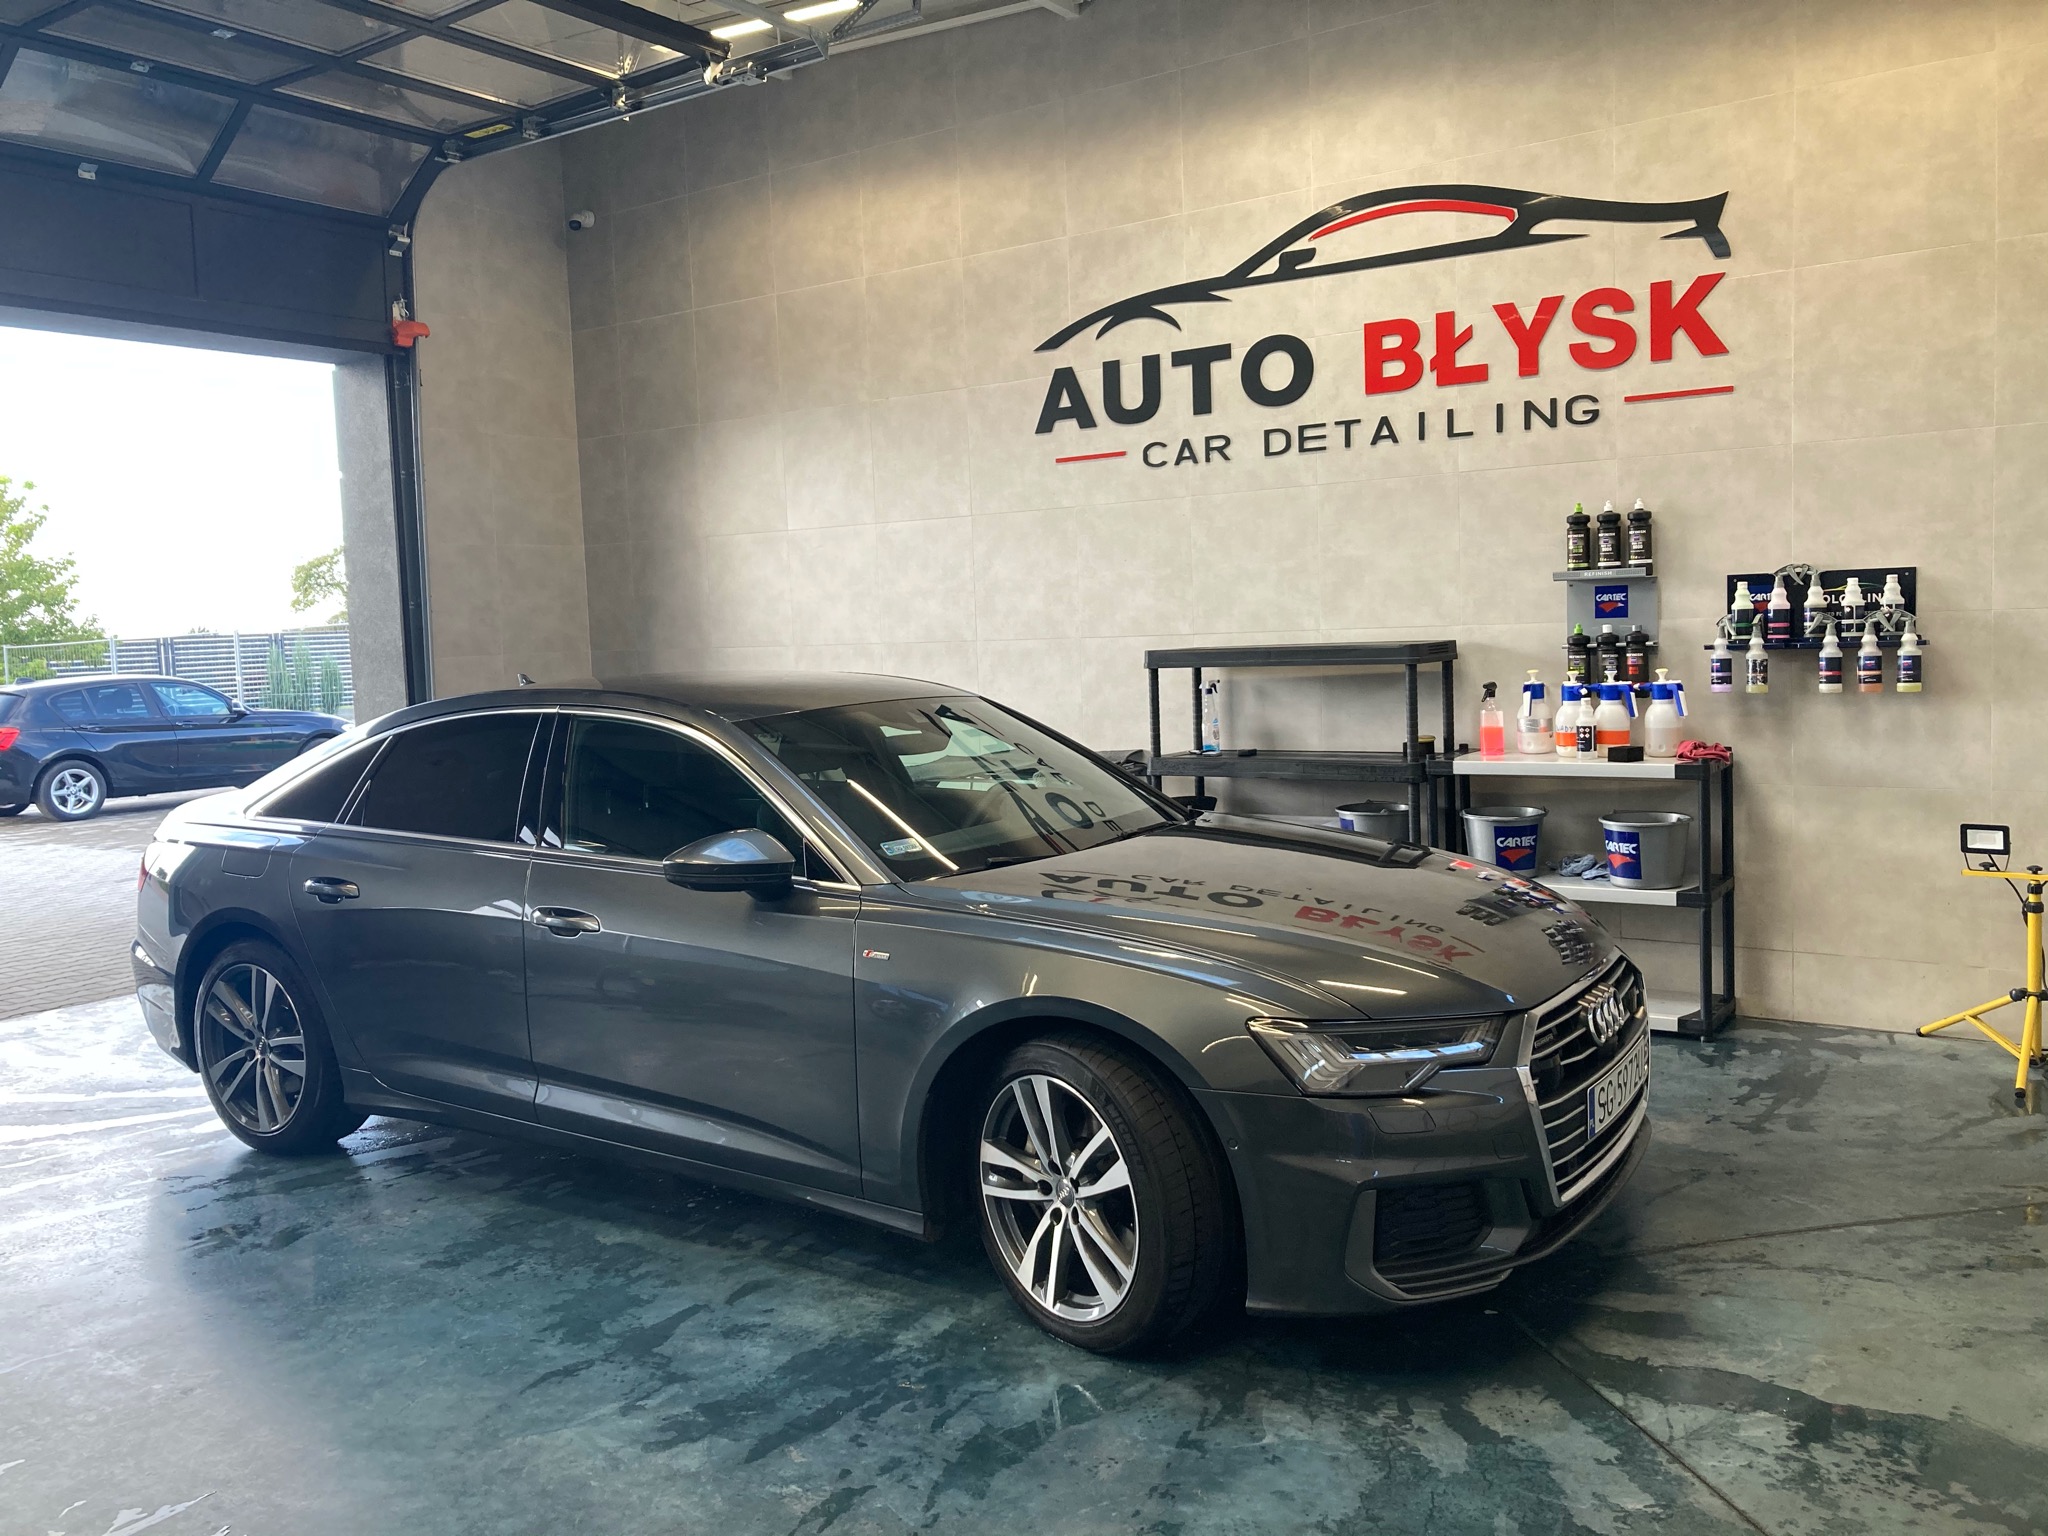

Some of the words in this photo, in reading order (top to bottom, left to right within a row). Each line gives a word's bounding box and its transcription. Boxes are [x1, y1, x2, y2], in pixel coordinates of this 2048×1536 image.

[1034, 334, 1315, 434] AUTO
[1363, 271, 1729, 396] BŁYSK
[1142, 434, 1232, 468] CAR
[1263, 394, 1602, 458] DETAILING
[1595, 592, 1627, 602] CARTEC
[1749, 592, 1772, 601] CART
[1496, 834, 1537, 848] CARTEC
[1604, 838, 1640, 855] CARTEC
[1597, 1079, 1614, 1124] SG
